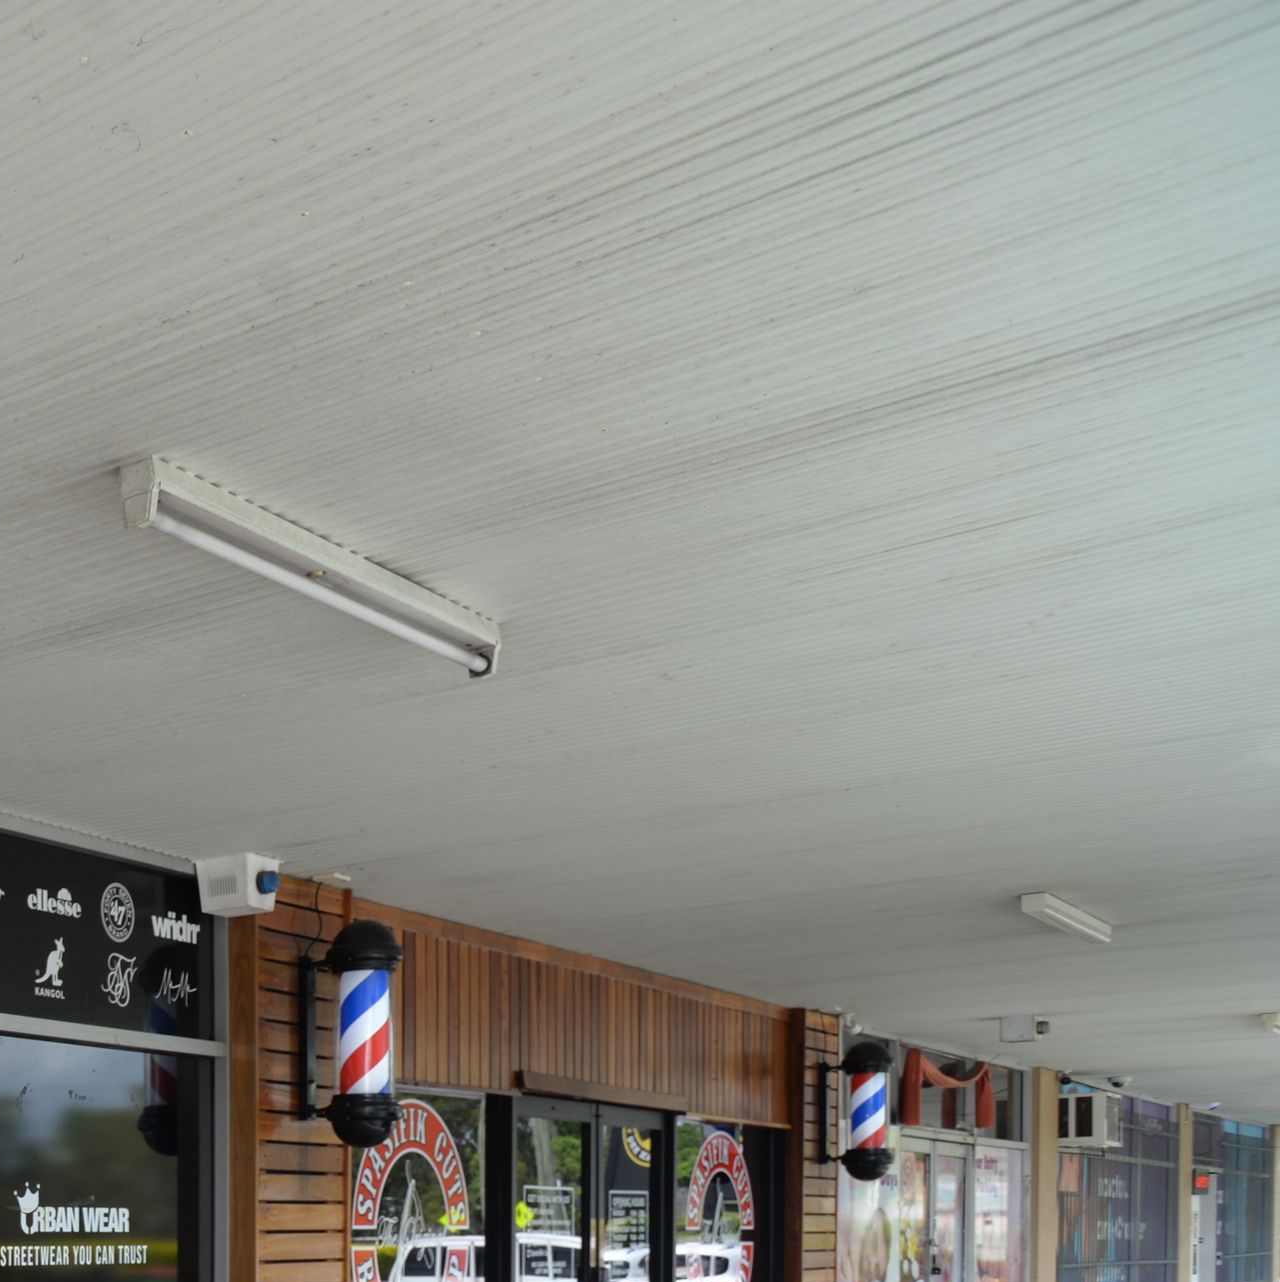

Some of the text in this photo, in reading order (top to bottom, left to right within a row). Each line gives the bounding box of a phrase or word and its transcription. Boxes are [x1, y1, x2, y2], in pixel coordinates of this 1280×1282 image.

[27, 888, 83, 918] ellesse
[34, 986, 66, 1000] KANGOL
[433, 1131, 466, 1224] CUTS
[19, 1206, 130, 1235] URBAN WEAR
[0, 1244, 149, 1267] STREETWEAR YOU CAN TRUST
